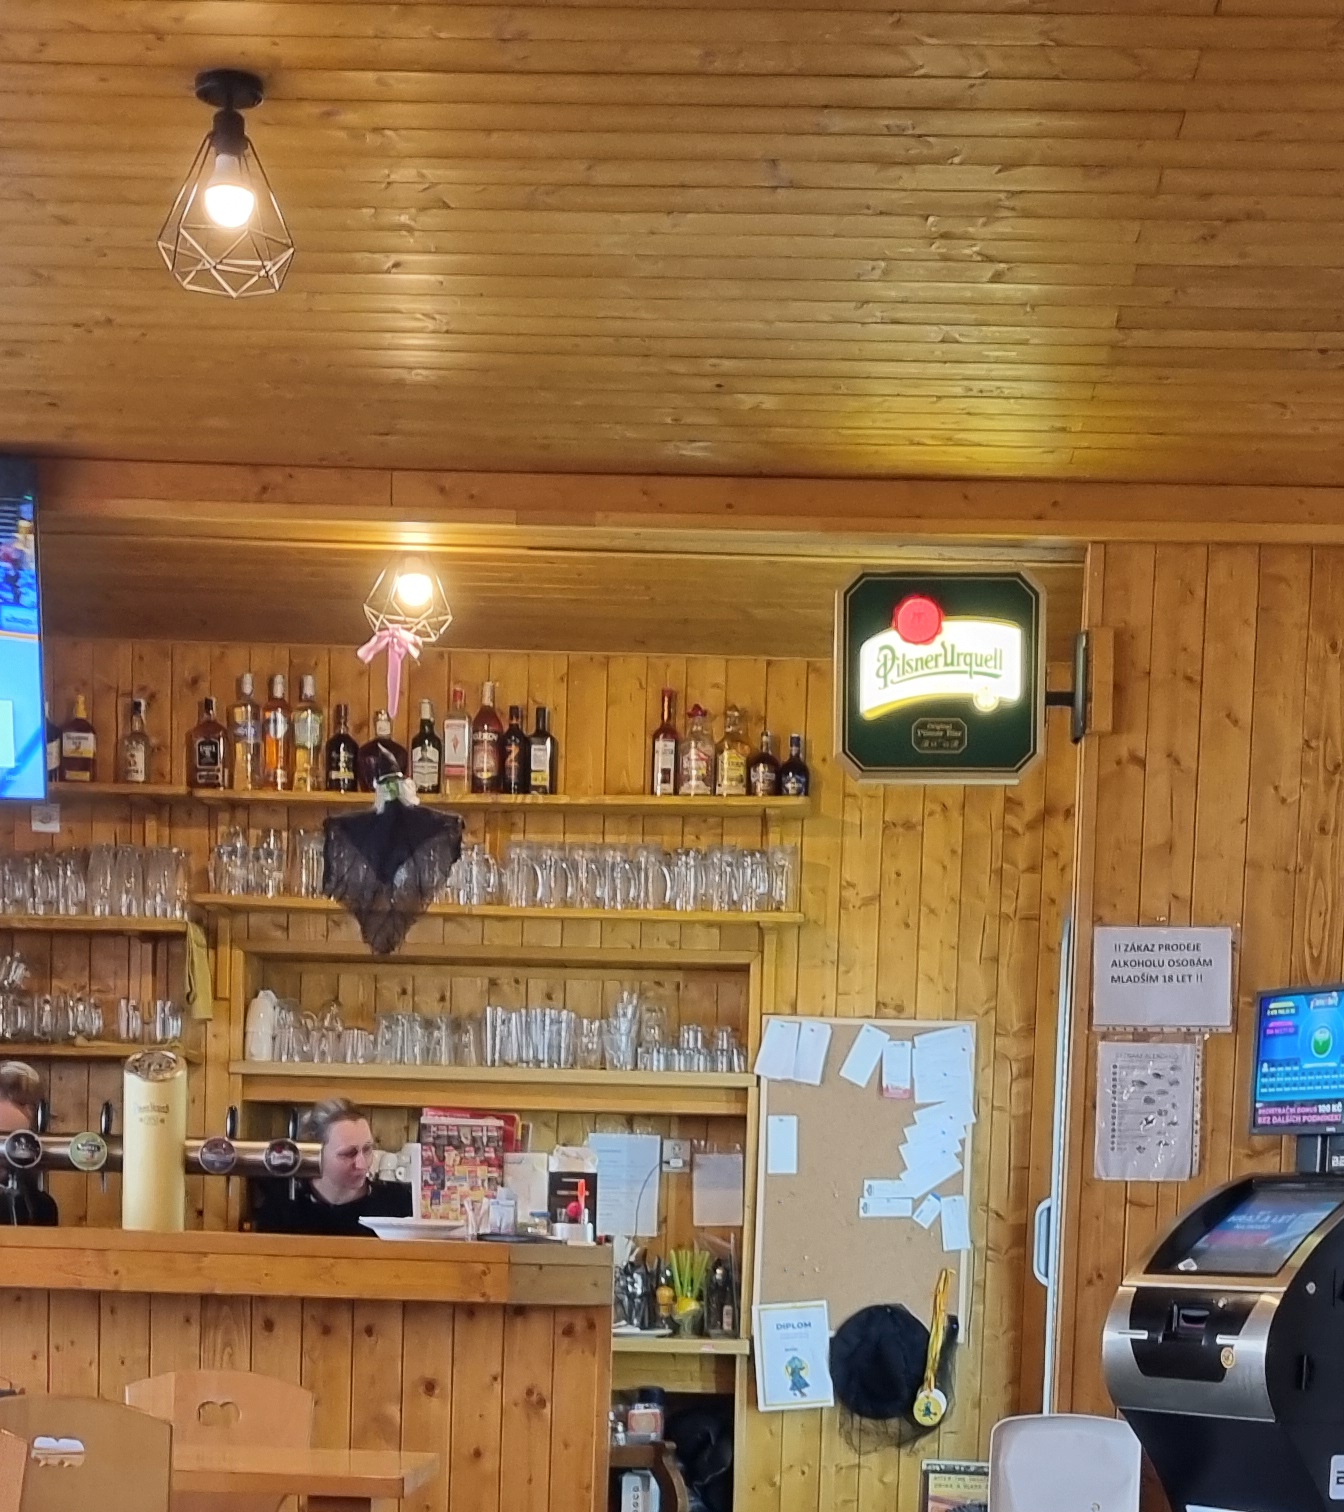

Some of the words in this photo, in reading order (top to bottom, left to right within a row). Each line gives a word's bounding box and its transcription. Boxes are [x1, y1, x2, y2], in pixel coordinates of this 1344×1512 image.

[875, 644, 943, 690] Pilsner
[941, 640, 1003, 679] Urquell
[1123, 941, 1156, 953] ZÁKAZ
[1158, 943, 1202, 952] PRODEJE
[1110, 958, 1165, 969] ALKOHOLU
[1167, 957, 1213, 968] OSOBÁM
[1110, 972, 1159, 984] MLADŠÍM
[1161, 974, 1174, 984] 18
[1176, 974, 1193, 984] LET
